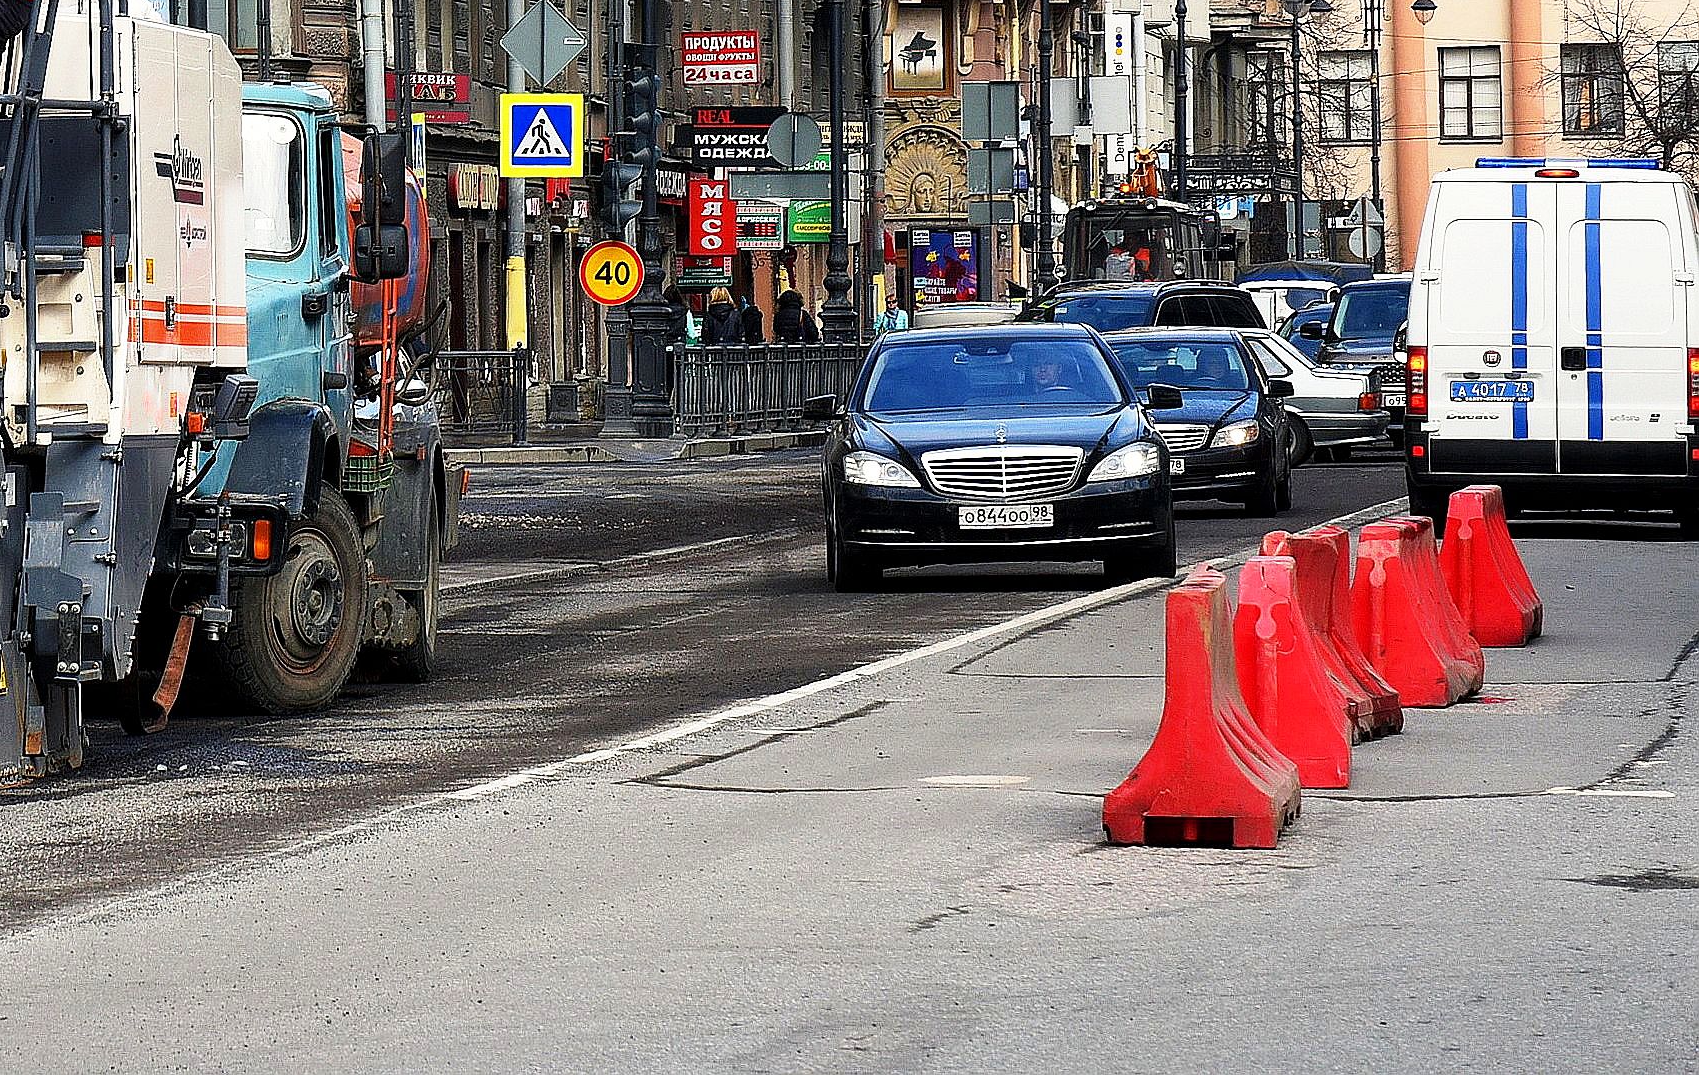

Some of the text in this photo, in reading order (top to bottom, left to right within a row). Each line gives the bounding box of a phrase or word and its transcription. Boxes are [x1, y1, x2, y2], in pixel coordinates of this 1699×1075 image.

[684, 36, 755, 52] ПРОДУКТЫ
[685, 52, 755, 62] ОВОЩИ ФРУКТЫ
[402, 74, 456, 85] ИКВИК
[697, 109, 735, 124] REAL
[700, 184, 724, 250] МЯСО
[594, 260, 631, 286] 40
[1472, 383, 1507, 398] 4017
[1514, 382, 1529, 393] 78
[1171, 460, 1181, 469] 78
[1033, 506, 1048, 517] 98
